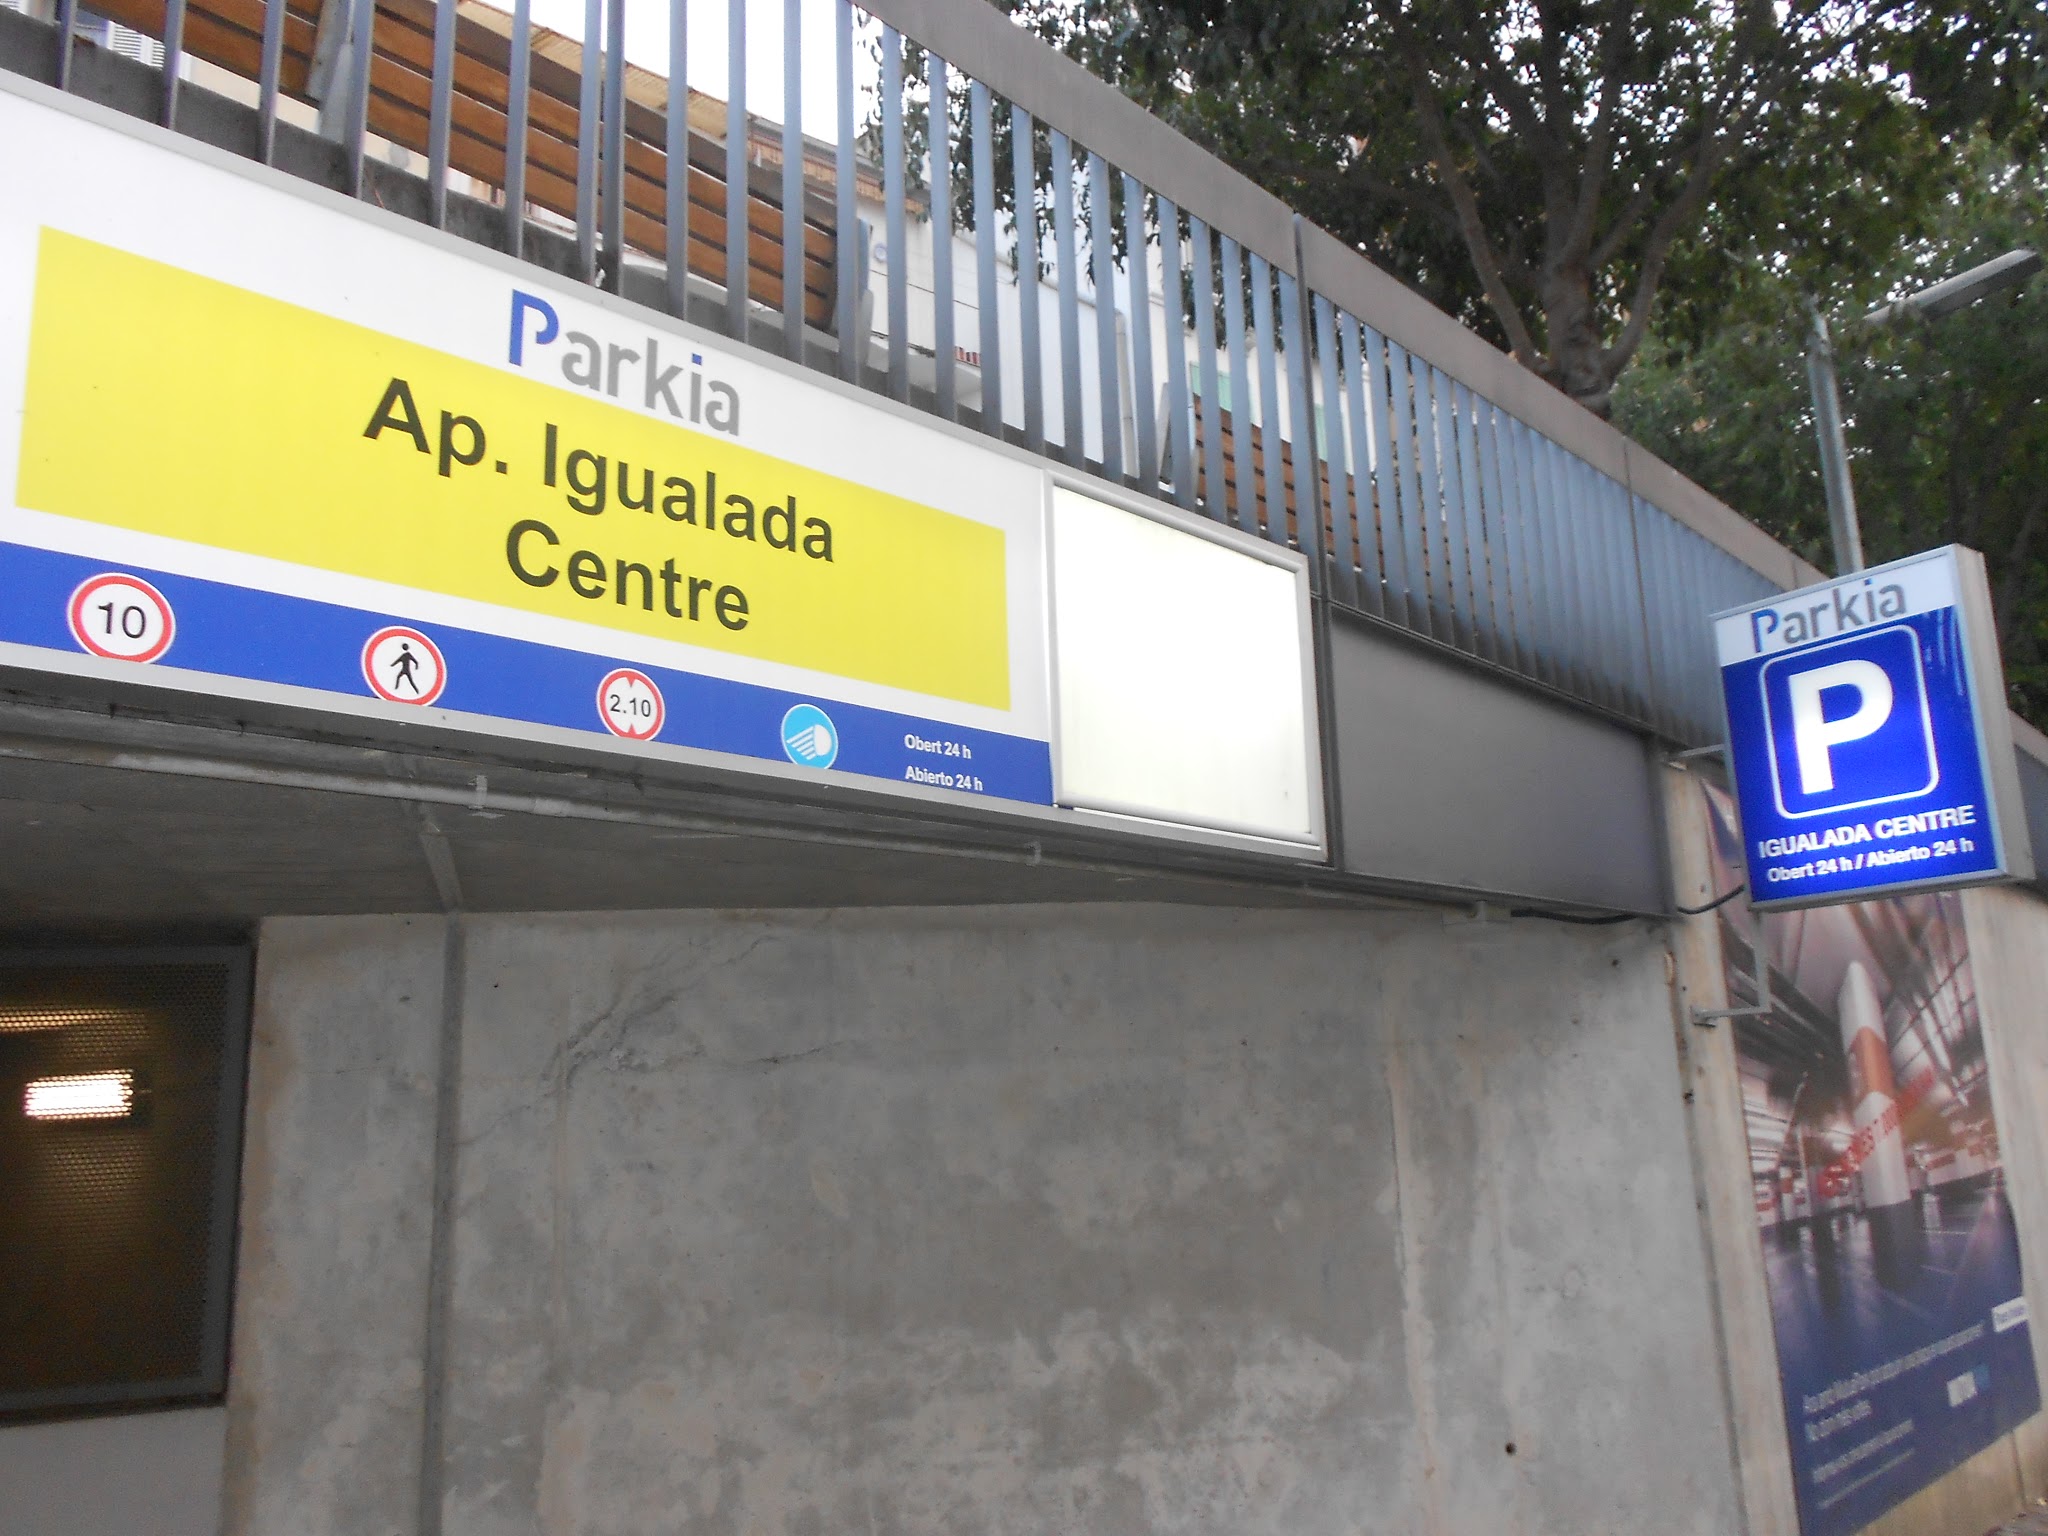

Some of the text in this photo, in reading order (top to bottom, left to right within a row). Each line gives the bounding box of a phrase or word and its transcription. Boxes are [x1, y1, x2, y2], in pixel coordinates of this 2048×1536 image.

[508, 289, 740, 436] Parkia
[362, 377, 834, 563] Ap. Igualada
[506, 519, 749, 631] Centre
[98, 602, 147, 639] 10
[1751, 579, 1907, 653] Parkia
[609, 694, 652, 718] 2.10
[1788, 659, 1894, 795] P
[904, 733, 972, 759] Obert 24 h
[905, 765, 983, 792] Abierto 24 h
[1758, 804, 1977, 858] IGUALADA CENTRE
[1767, 862, 1815, 882] Obert
[1816, 858, 1838, 875] 24
[1840, 856, 1854, 871] h
[1866, 845, 1930, 868] Abierto
[1932, 838, 1957, 857] 24
[1960, 837, 1975, 852] h
